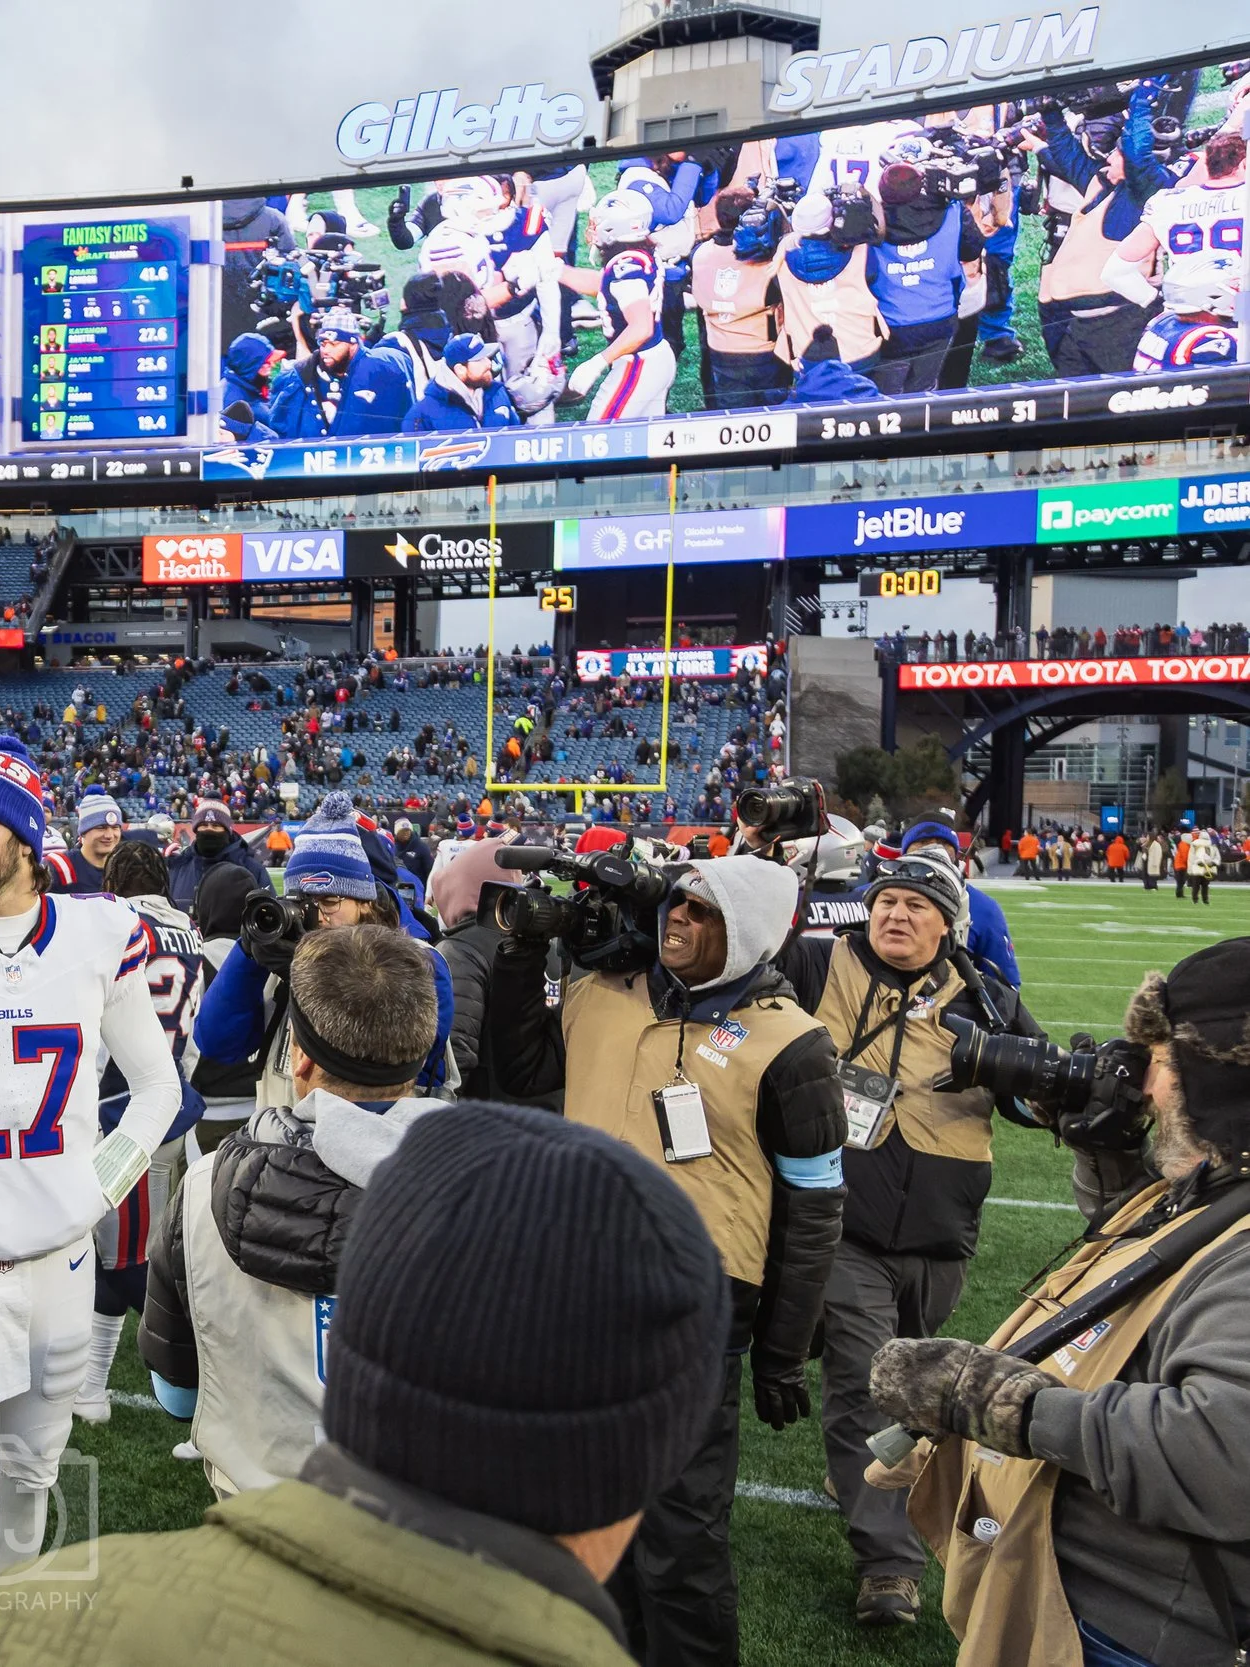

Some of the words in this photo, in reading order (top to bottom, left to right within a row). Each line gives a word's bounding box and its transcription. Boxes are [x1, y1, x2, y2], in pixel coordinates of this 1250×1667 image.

[338, 85, 585, 160] Gillette
[776, 8, 1099, 110] STADIUM
[63, 226, 111, 246] FANTASY
[113, 224, 148, 243] STATS
[952, 407, 979, 426] BALL
[981, 406, 999, 423] ON
[1012, 399, 1036, 423] 31
[1108, 384, 1209, 415] Gillette
[662, 429, 676, 449] 4
[719, 423, 771, 445] 0:00
[821, 418, 835, 441] 3
[877, 412, 901, 434] 12
[303, 450, 337, 473] NE
[359, 447, 386, 469] 23
[514, 437, 565, 462] BUF
[582, 433, 608, 459] 16
[106, 461, 124, 477] 22
[854, 507, 963, 547] jetBlue
[1075, 502, 1170, 528] paycom
[1203, 506, 1250, 524] COMP
[178, 537, 227, 560] CVS
[246, 538, 341, 573] VISA
[420, 556, 503, 570] INSURANCE
[880, 570, 940, 597] 0:00
[541, 587, 573, 612] 25
[53, 632, 117, 644] BEACON
[652, 661, 674, 676] AIR
[676, 660, 716, 676] FORCE
[911, 663, 1017, 688] TOYOTA
[1027, 660, 1137, 685] TOYOTA
[1147, 657, 1250, 682] TOYOTA
[713, 1028, 737, 1048] NFL
[695, 1043, 728, 1069] MEDIA
